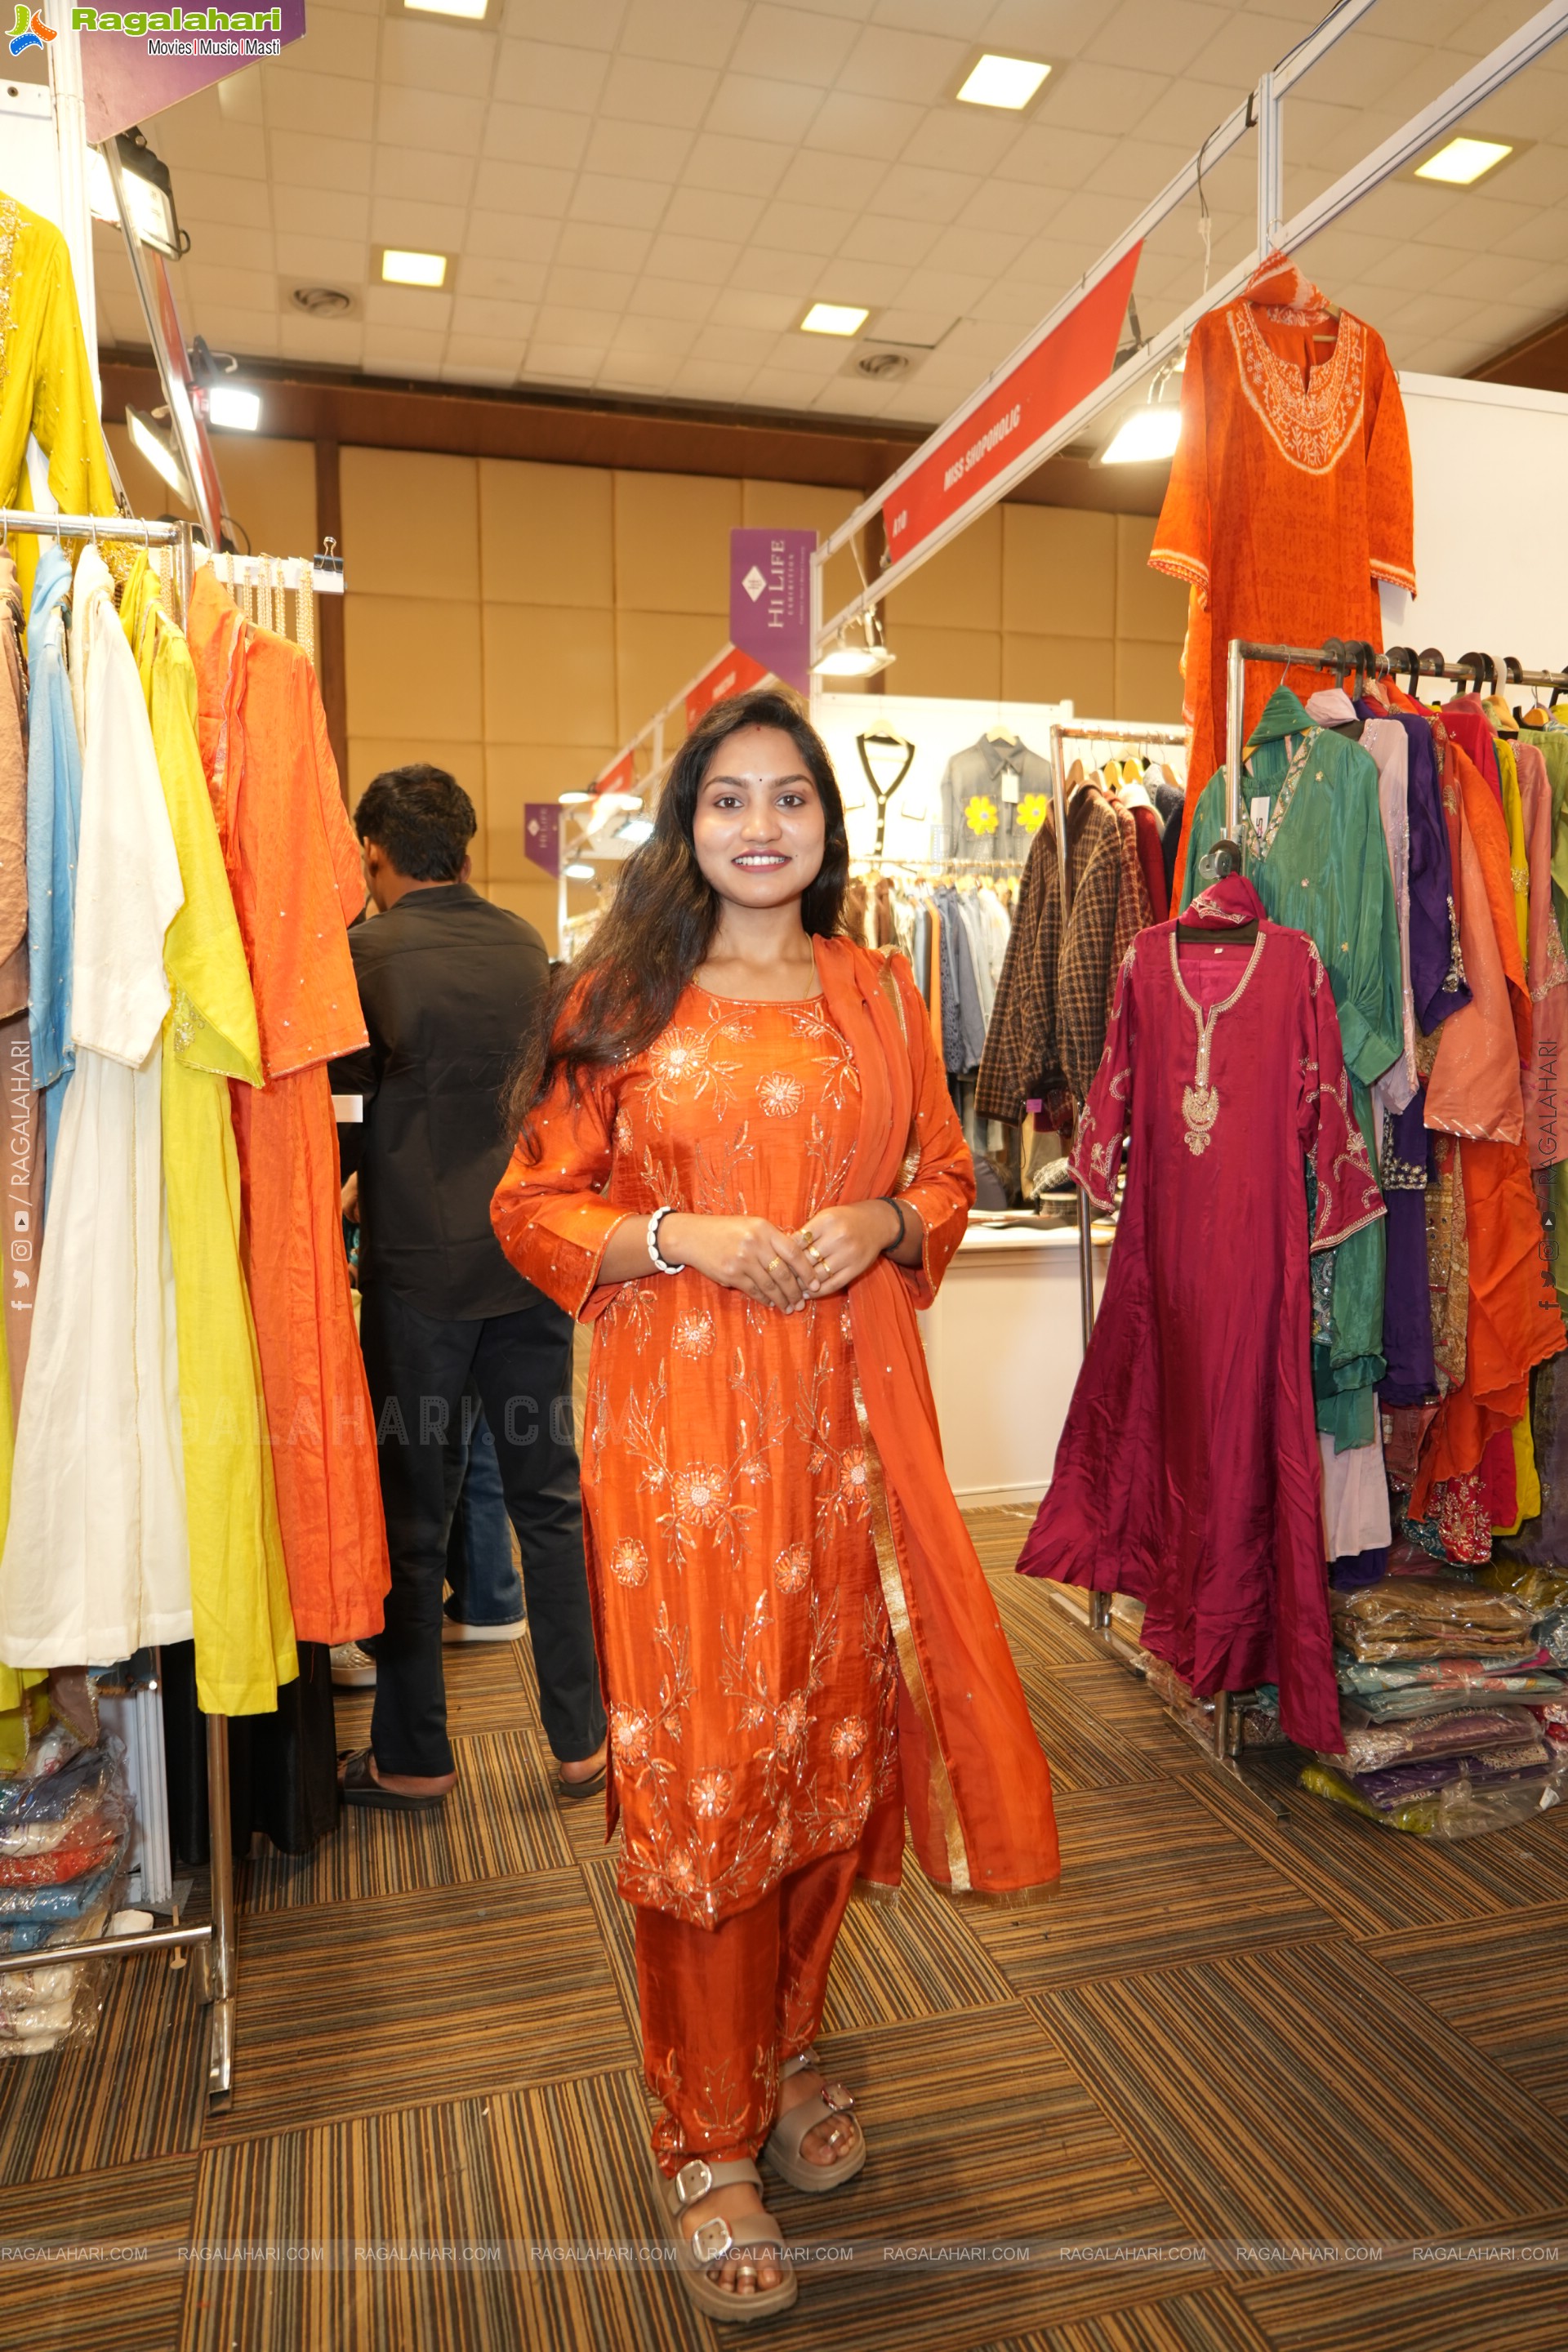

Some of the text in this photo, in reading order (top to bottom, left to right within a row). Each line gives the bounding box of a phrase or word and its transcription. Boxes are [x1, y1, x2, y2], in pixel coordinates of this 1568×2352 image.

[943, 457, 964, 492] MISS
[768, 540, 785, 628] HI LIFE
